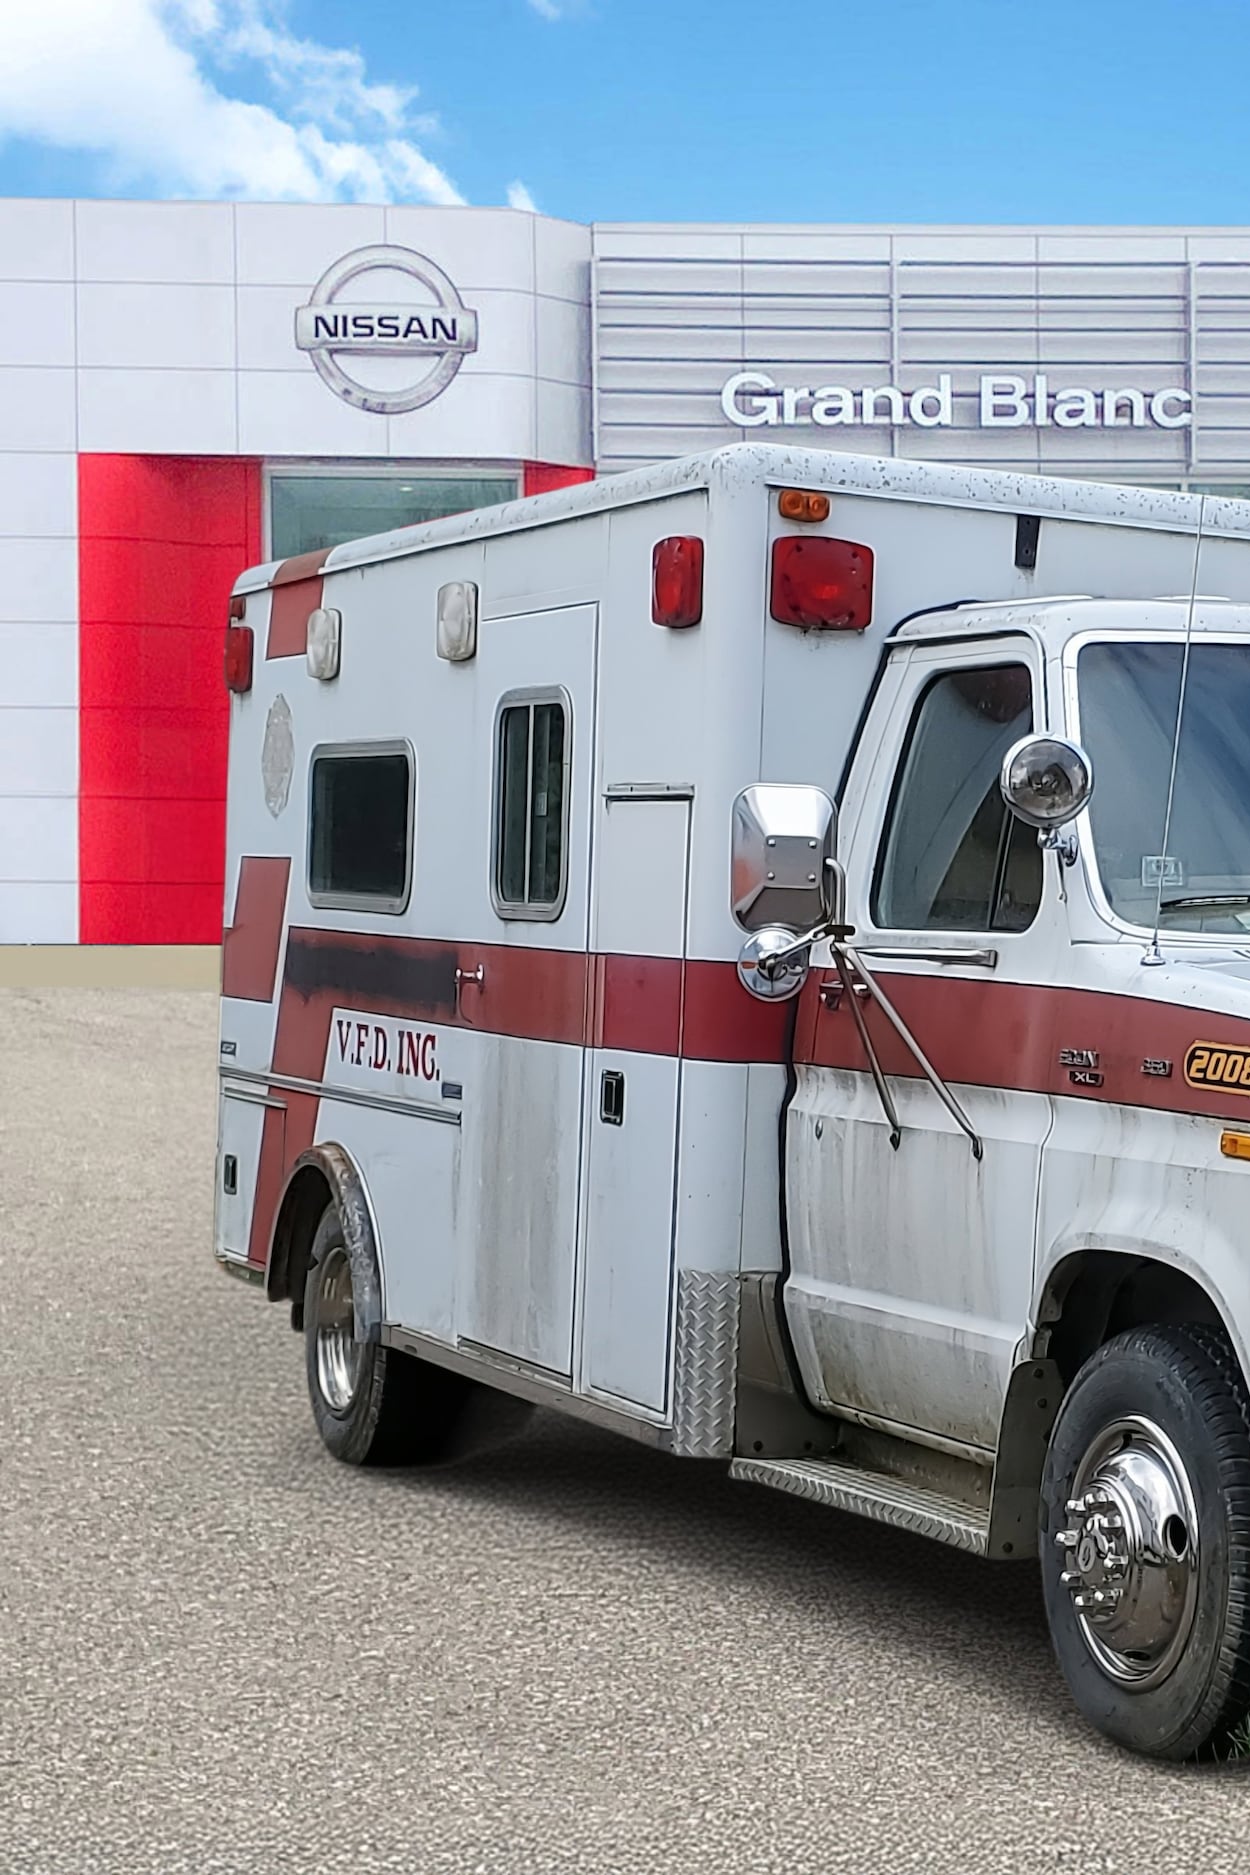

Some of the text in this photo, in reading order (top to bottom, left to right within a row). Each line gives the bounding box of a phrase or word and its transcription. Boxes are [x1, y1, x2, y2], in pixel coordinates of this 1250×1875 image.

[314, 314, 457, 341] NISSAN
[720, 372, 1193, 428] Grand Blanc
[336, 1019, 440, 1081] V.F.D. INC.
[1074, 1071, 1096, 1084] XL
